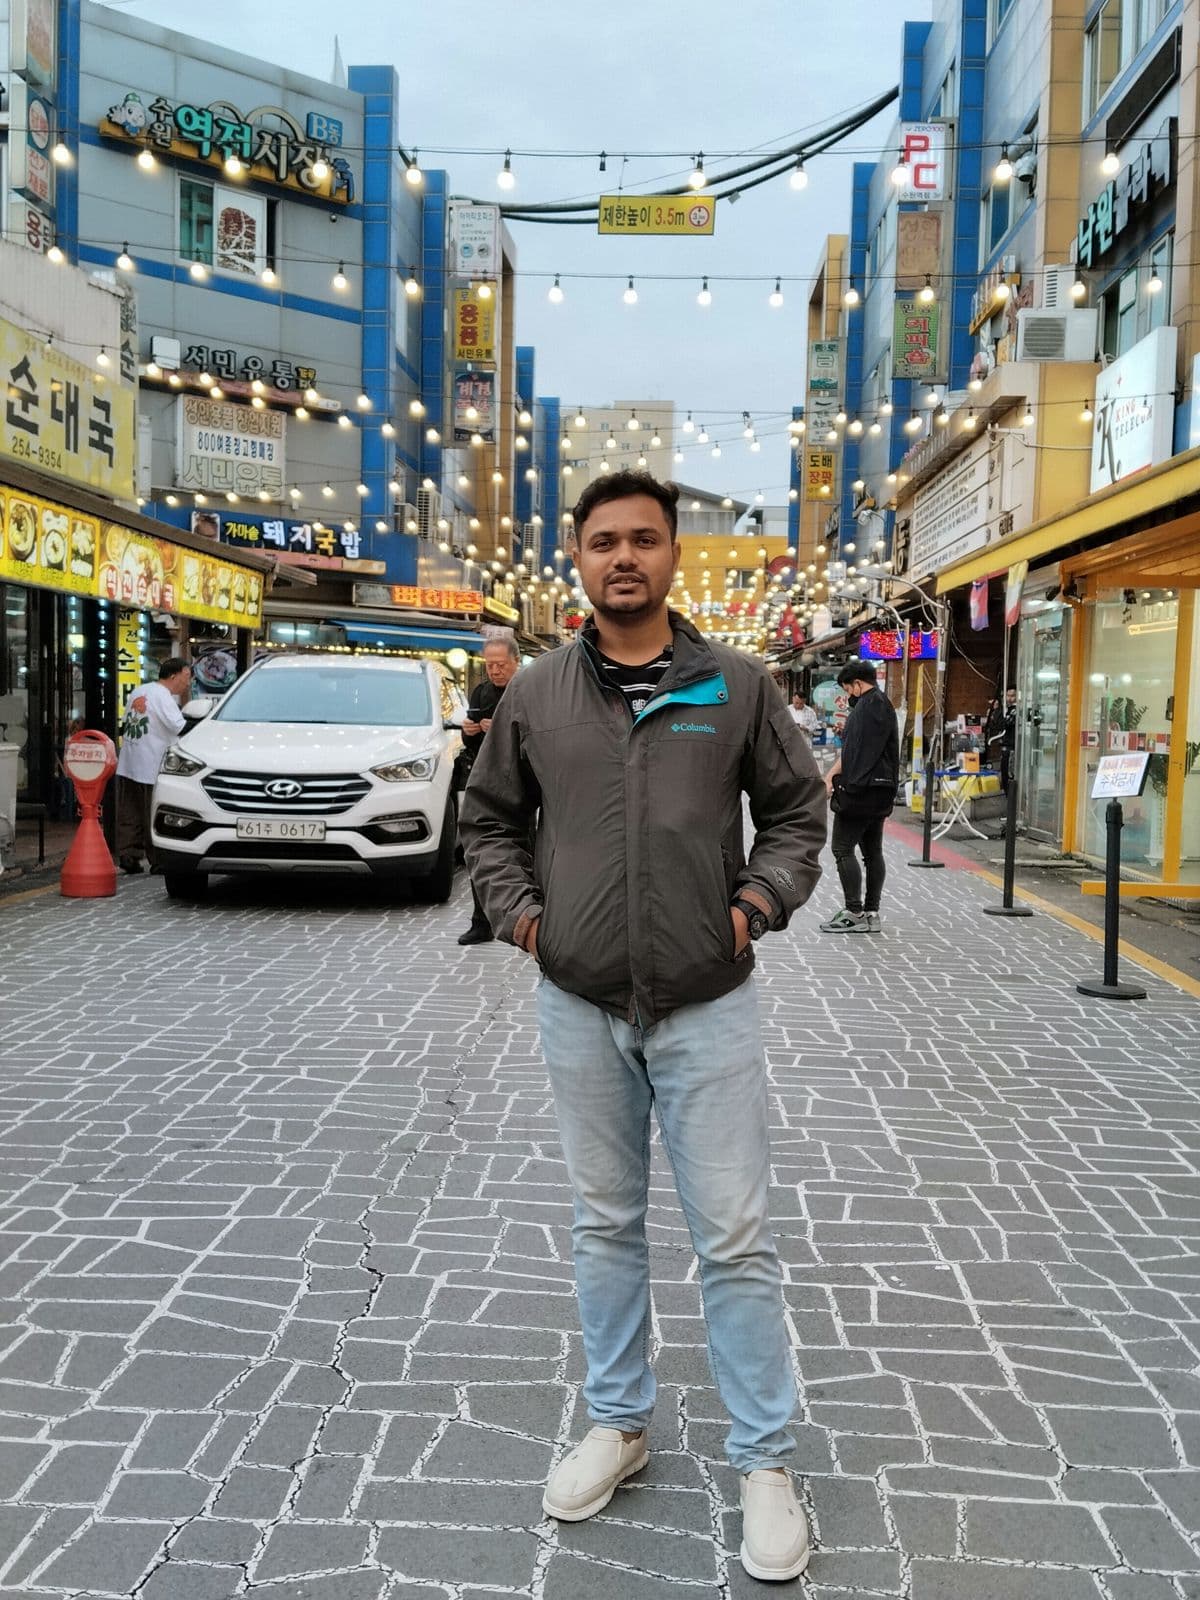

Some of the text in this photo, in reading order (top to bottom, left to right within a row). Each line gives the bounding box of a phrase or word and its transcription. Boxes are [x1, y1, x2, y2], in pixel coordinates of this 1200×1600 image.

[310, 112, 342, 145] B동
[602, 205, 685, 227] 제한높이 3.5m
[185, 345, 295, 390] 서민유통
[6, 355, 114, 469] 순대국
[185, 400, 283, 440] 성인용품 창업지원
[12, 435, 63, 469] 254-9354
[809, 454, 833, 468] 도배
[184, 455, 283, 498] 서민유통
[225, 520, 362, 559] 가마솥 돼지국밥
[680, 722, 717, 734] Columbia
[280, 823, 317, 837] 0617
